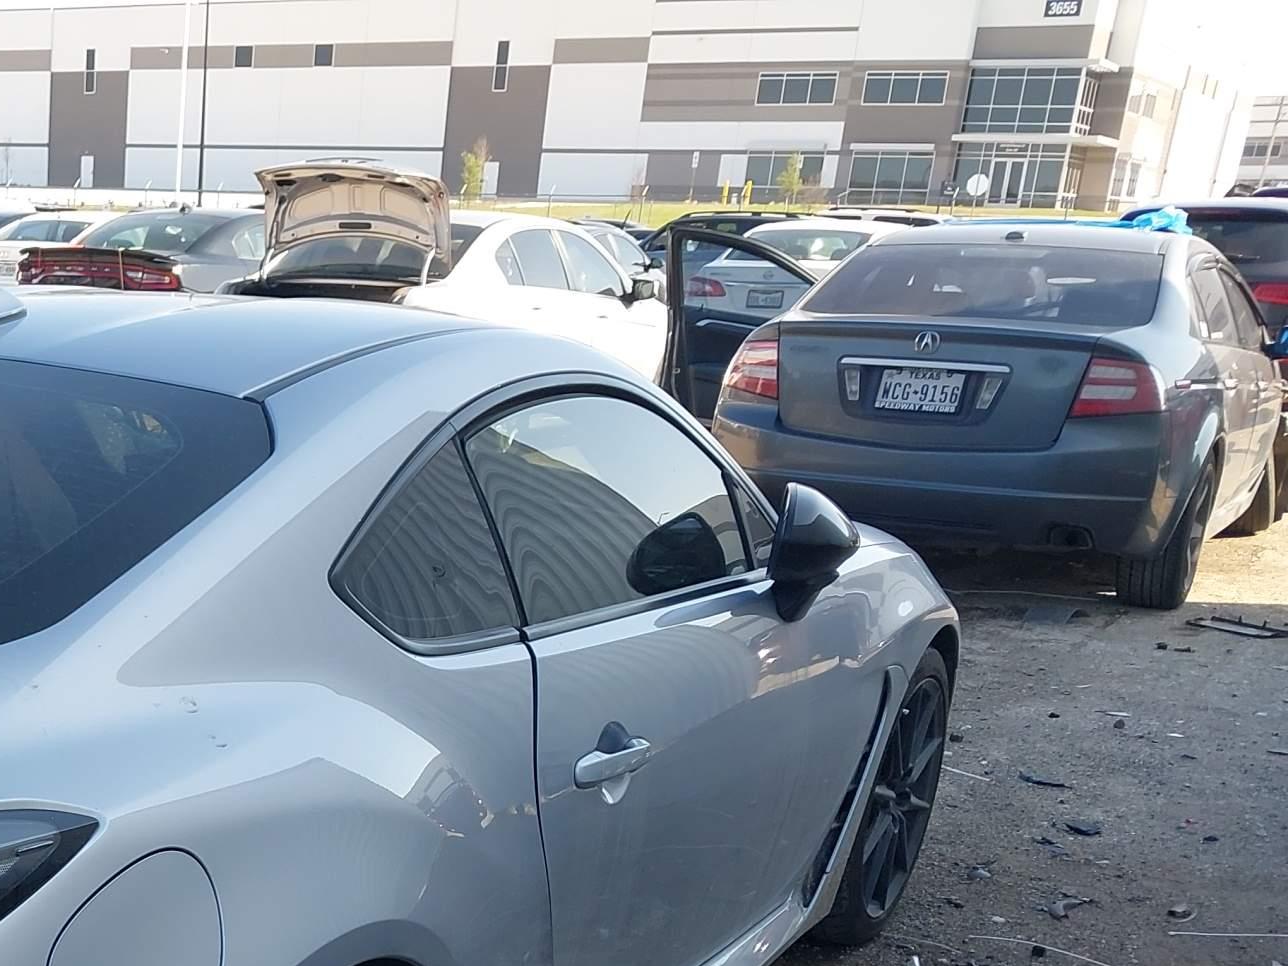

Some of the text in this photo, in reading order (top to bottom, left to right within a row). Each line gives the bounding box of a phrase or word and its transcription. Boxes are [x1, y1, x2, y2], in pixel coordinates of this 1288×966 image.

[1047, 1, 1078, 15] 3655
[909, 368, 941, 380] TEXAS
[874, 401, 956, 413] SPEEDWAY MOTORS
